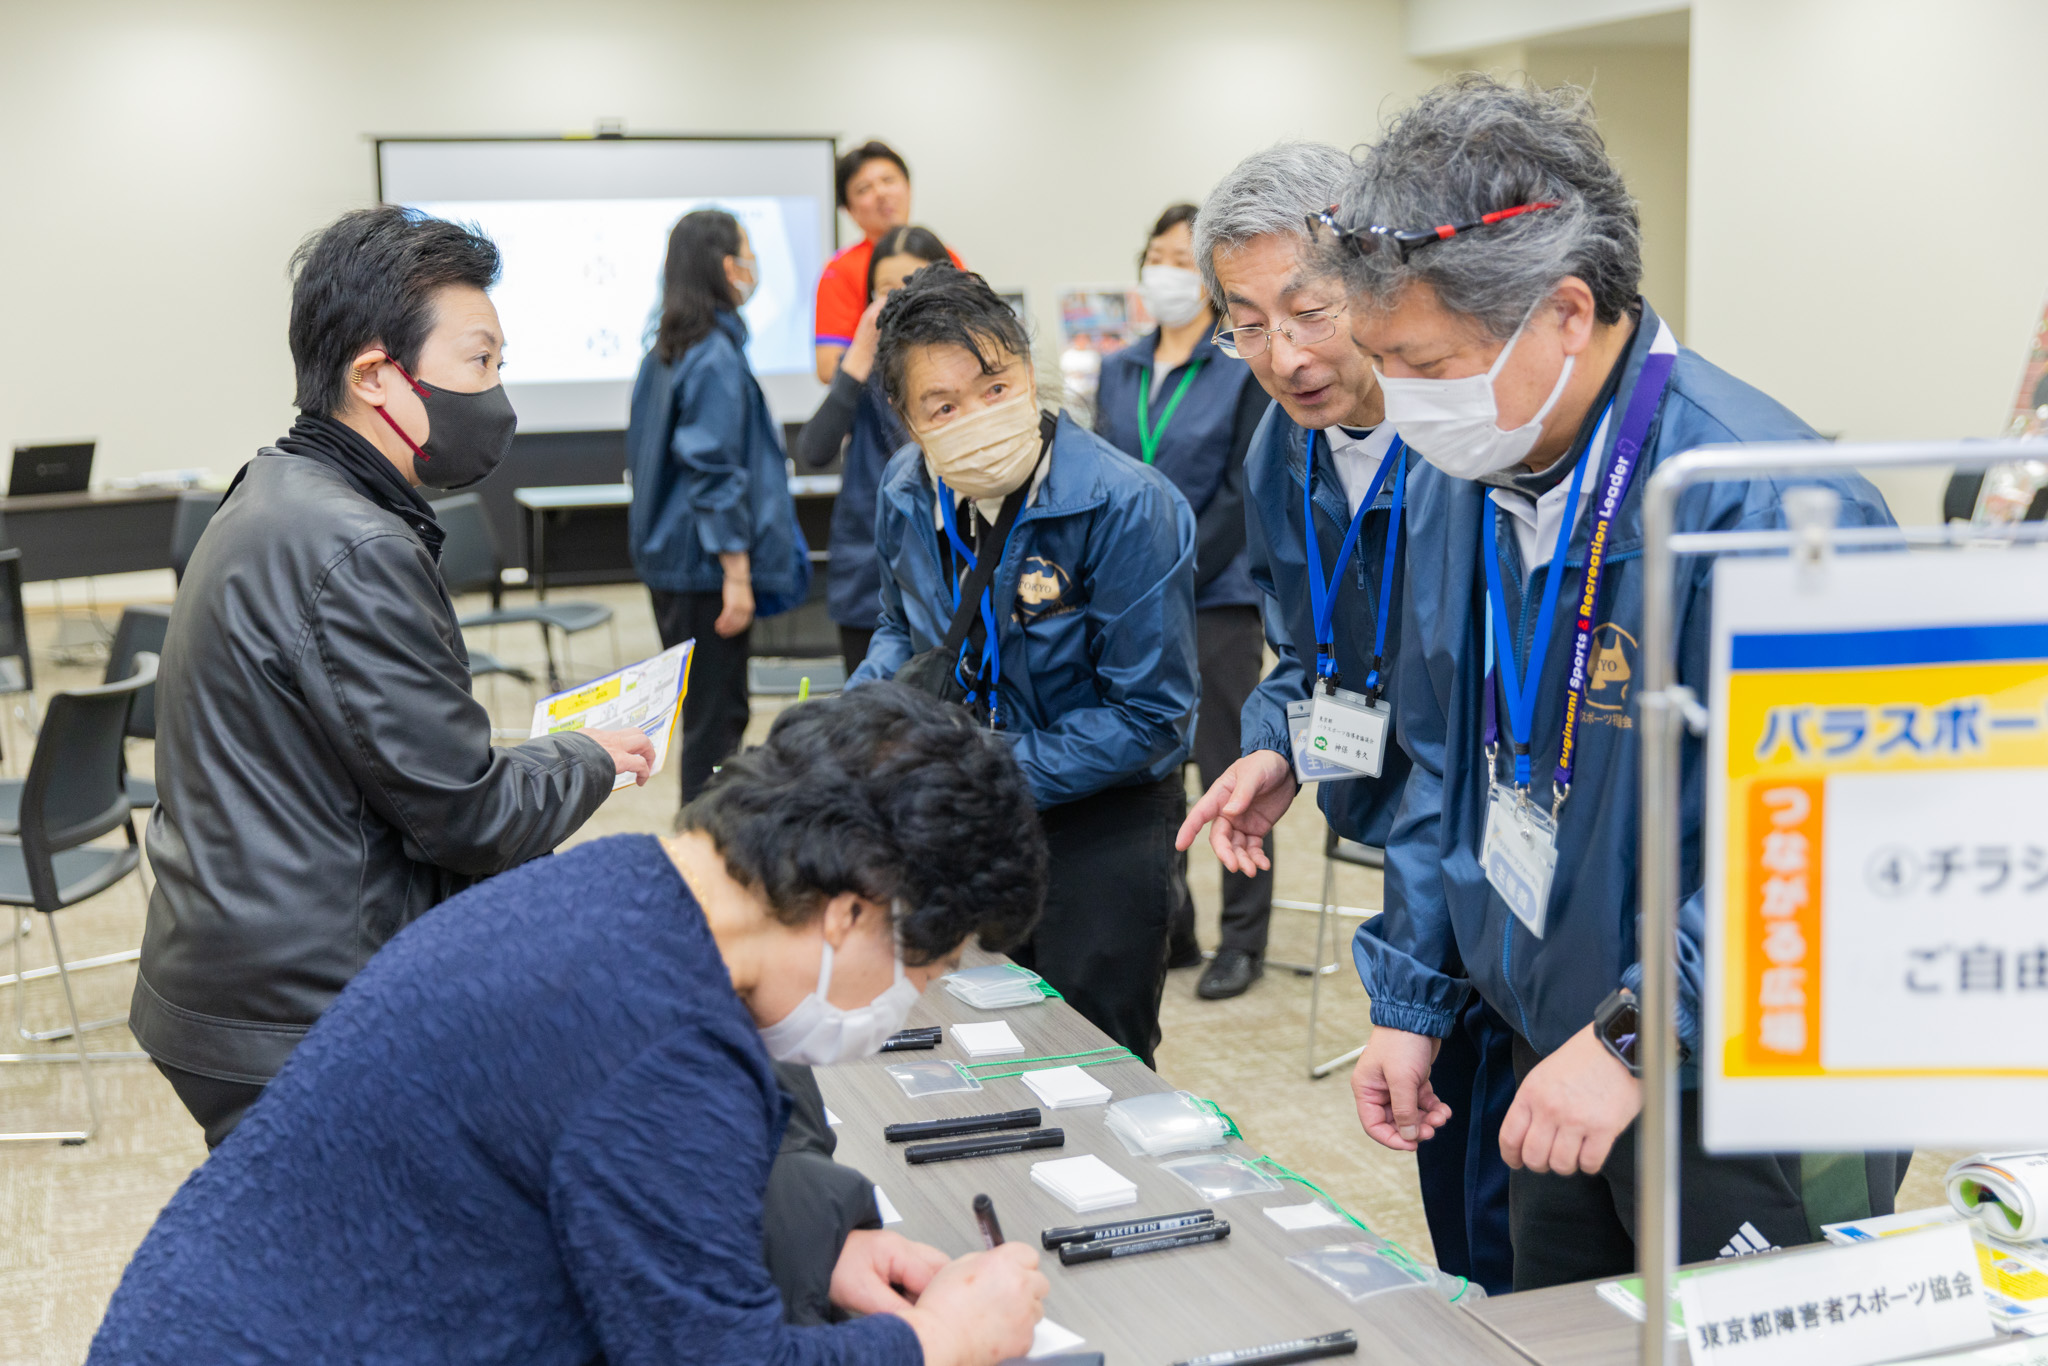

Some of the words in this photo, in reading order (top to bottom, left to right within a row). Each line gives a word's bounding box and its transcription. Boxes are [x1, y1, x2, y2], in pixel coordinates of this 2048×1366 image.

[1599, 456, 1630, 518] Leader
[1580, 520, 1609, 617] Recreation
[1578, 620, 1590, 631] &
[1570, 632, 1588, 689] Sports
[1560, 690, 1578, 768] suginami
[1095, 1226, 1135, 1240] MARKER
[1138, 1222, 1157, 1233] PEN
[1698, 1270, 1974, 1350] 東京都障害者スポーツ協会
